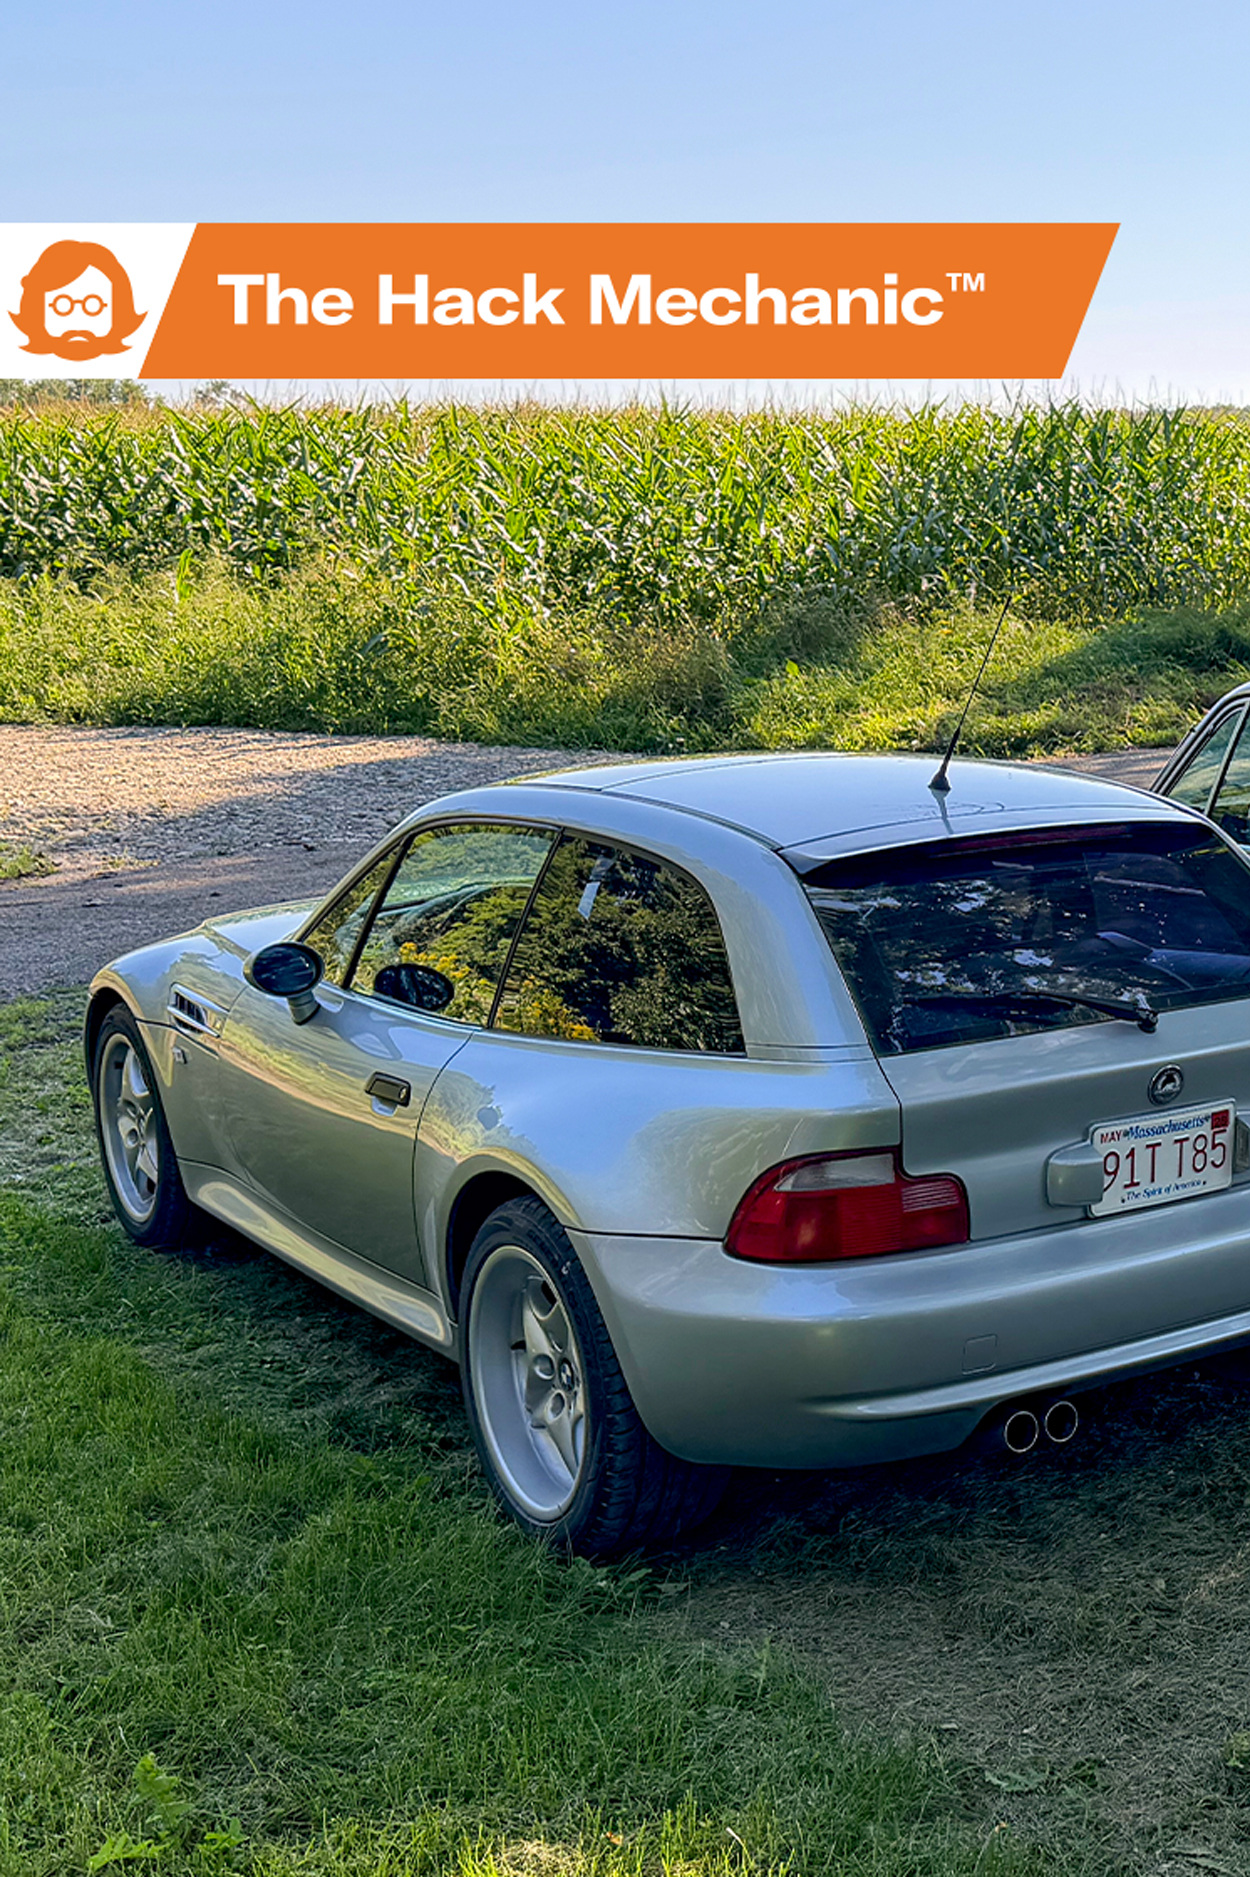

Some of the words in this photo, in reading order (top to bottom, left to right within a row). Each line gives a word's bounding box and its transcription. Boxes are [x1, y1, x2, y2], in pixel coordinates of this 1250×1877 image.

[1101, 1131, 1122, 1144] MAY
[1128, 1116, 1205, 1140] Massachusetts
[1103, 1142, 1162, 1192] 91T
[1174, 1129, 1227, 1177] T85
[1126, 1190, 1142, 1201] The
[1143, 1186, 1162, 1199] Spirit
[1164, 1184, 1173, 1195] of
